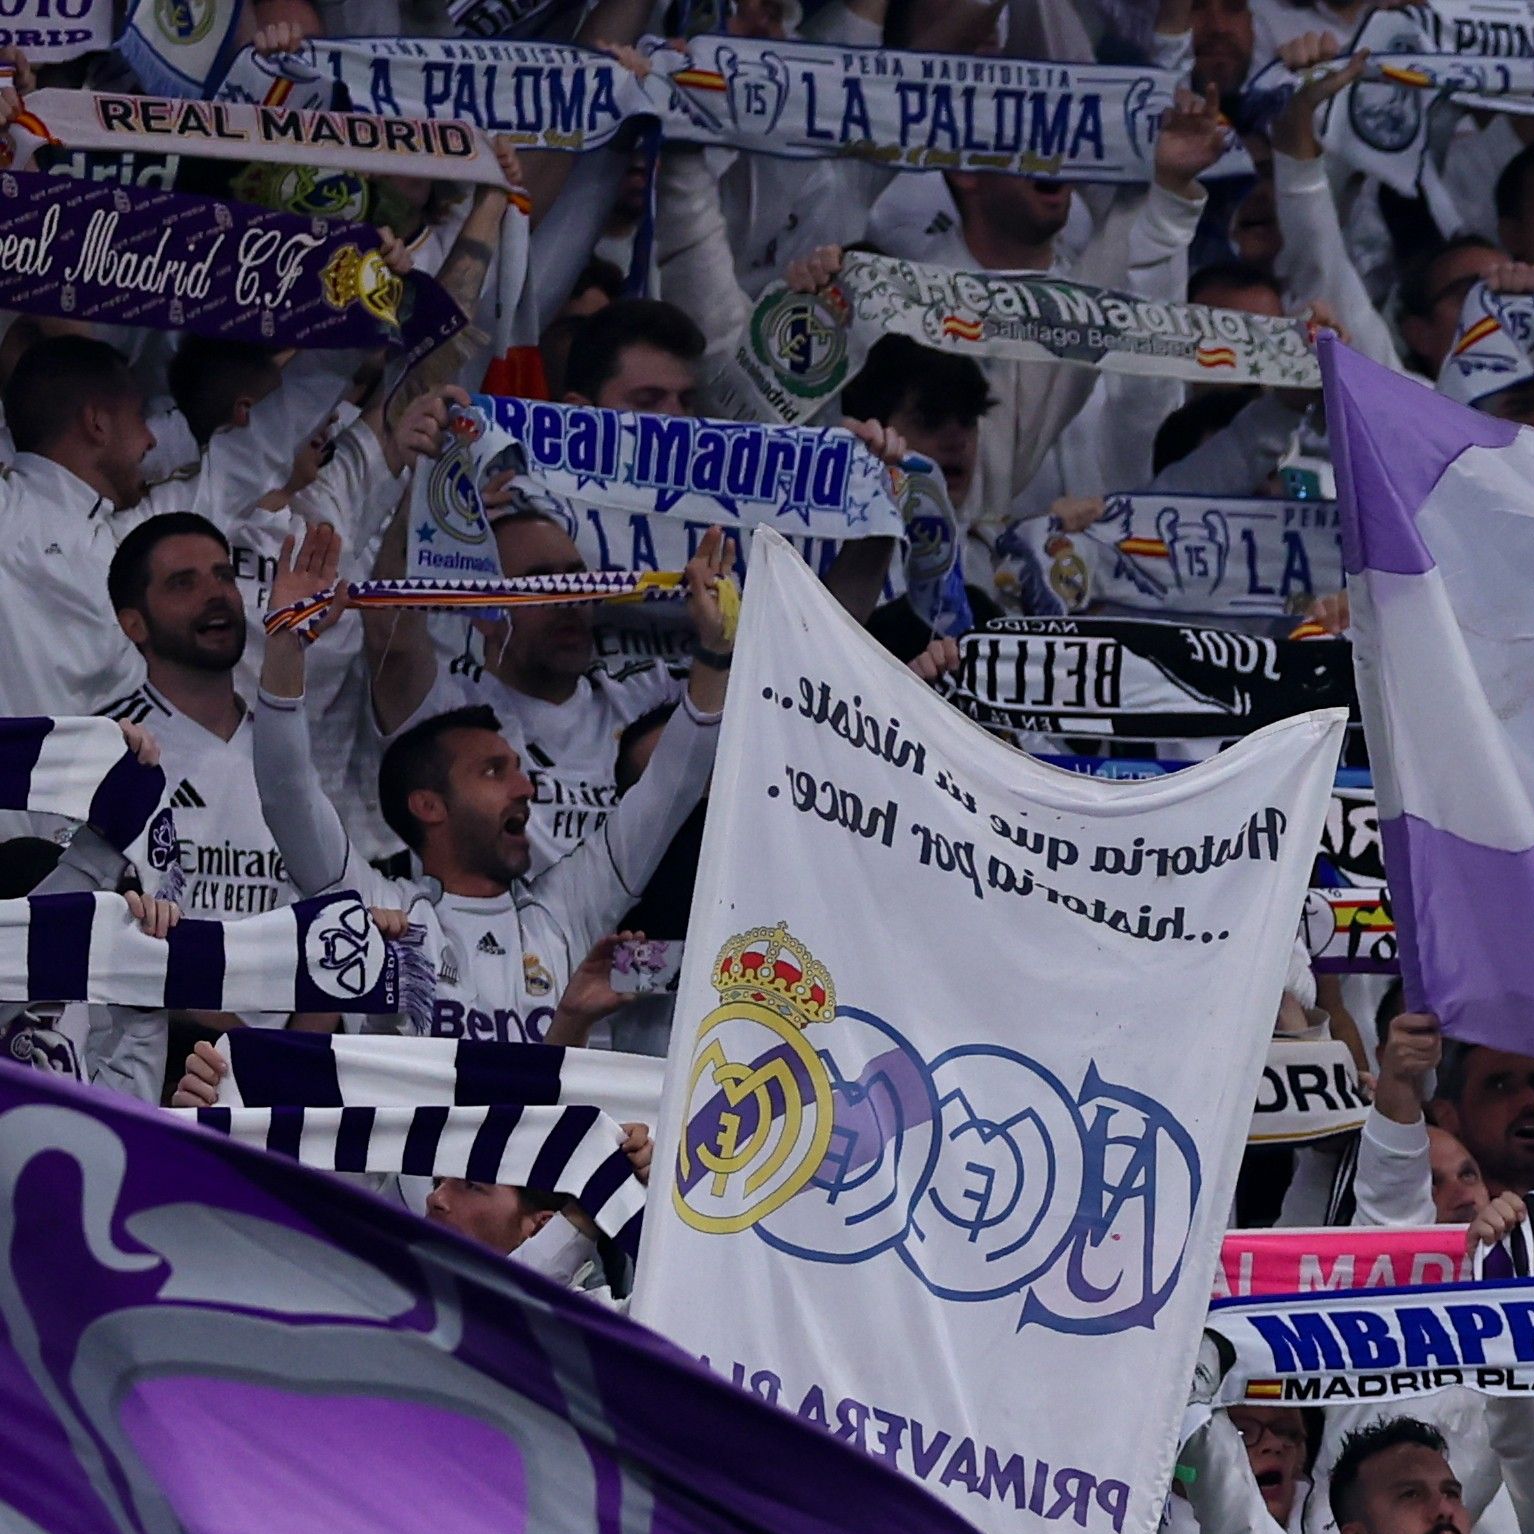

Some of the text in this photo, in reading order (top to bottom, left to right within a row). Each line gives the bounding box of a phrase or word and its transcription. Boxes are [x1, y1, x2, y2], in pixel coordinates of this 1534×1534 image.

[98, 97, 477, 158] REAL MADRID
[329, 50, 623, 132] LA PALOMA
[803, 70, 1106, 161] LA PALOMA
[0, 204, 56, 277] eal
[65, 207, 227, 301] Madrid
[918, 260, 1251, 345] Real Madrid
[492, 396, 852, 514] Real Madrid
[1242, 531, 1311, 597] LA
[173, 838, 288, 882] Emirate
[192, 879, 220, 910] FLY
